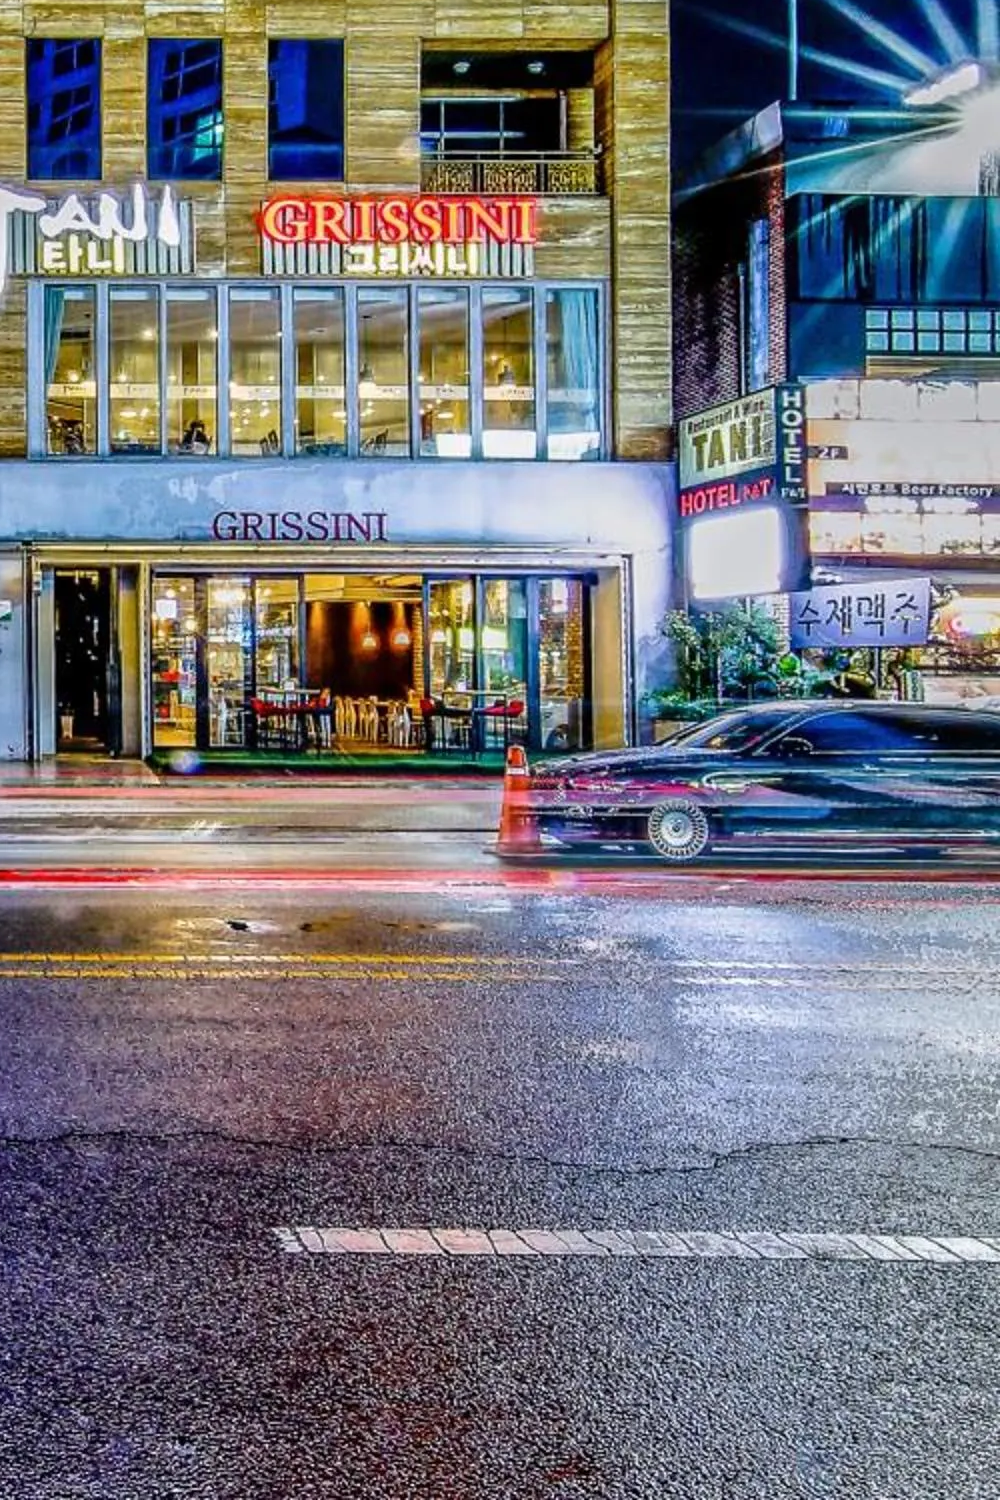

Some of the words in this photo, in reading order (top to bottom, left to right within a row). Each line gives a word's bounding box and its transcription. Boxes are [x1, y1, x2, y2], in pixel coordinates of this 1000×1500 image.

[262, 198, 538, 243] GRISSINI
[42, 233, 125, 274] 타니
[345, 242, 479, 276] 그리씨니
[781, 388, 804, 483] HOTEL
[680, 482, 741, 517] HOTEL
[901, 482, 936, 495] Beer
[938, 482, 993, 498] Factory
[212, 511, 389, 542] GRISSINI
[796, 592, 920, 638] 수제맥주
